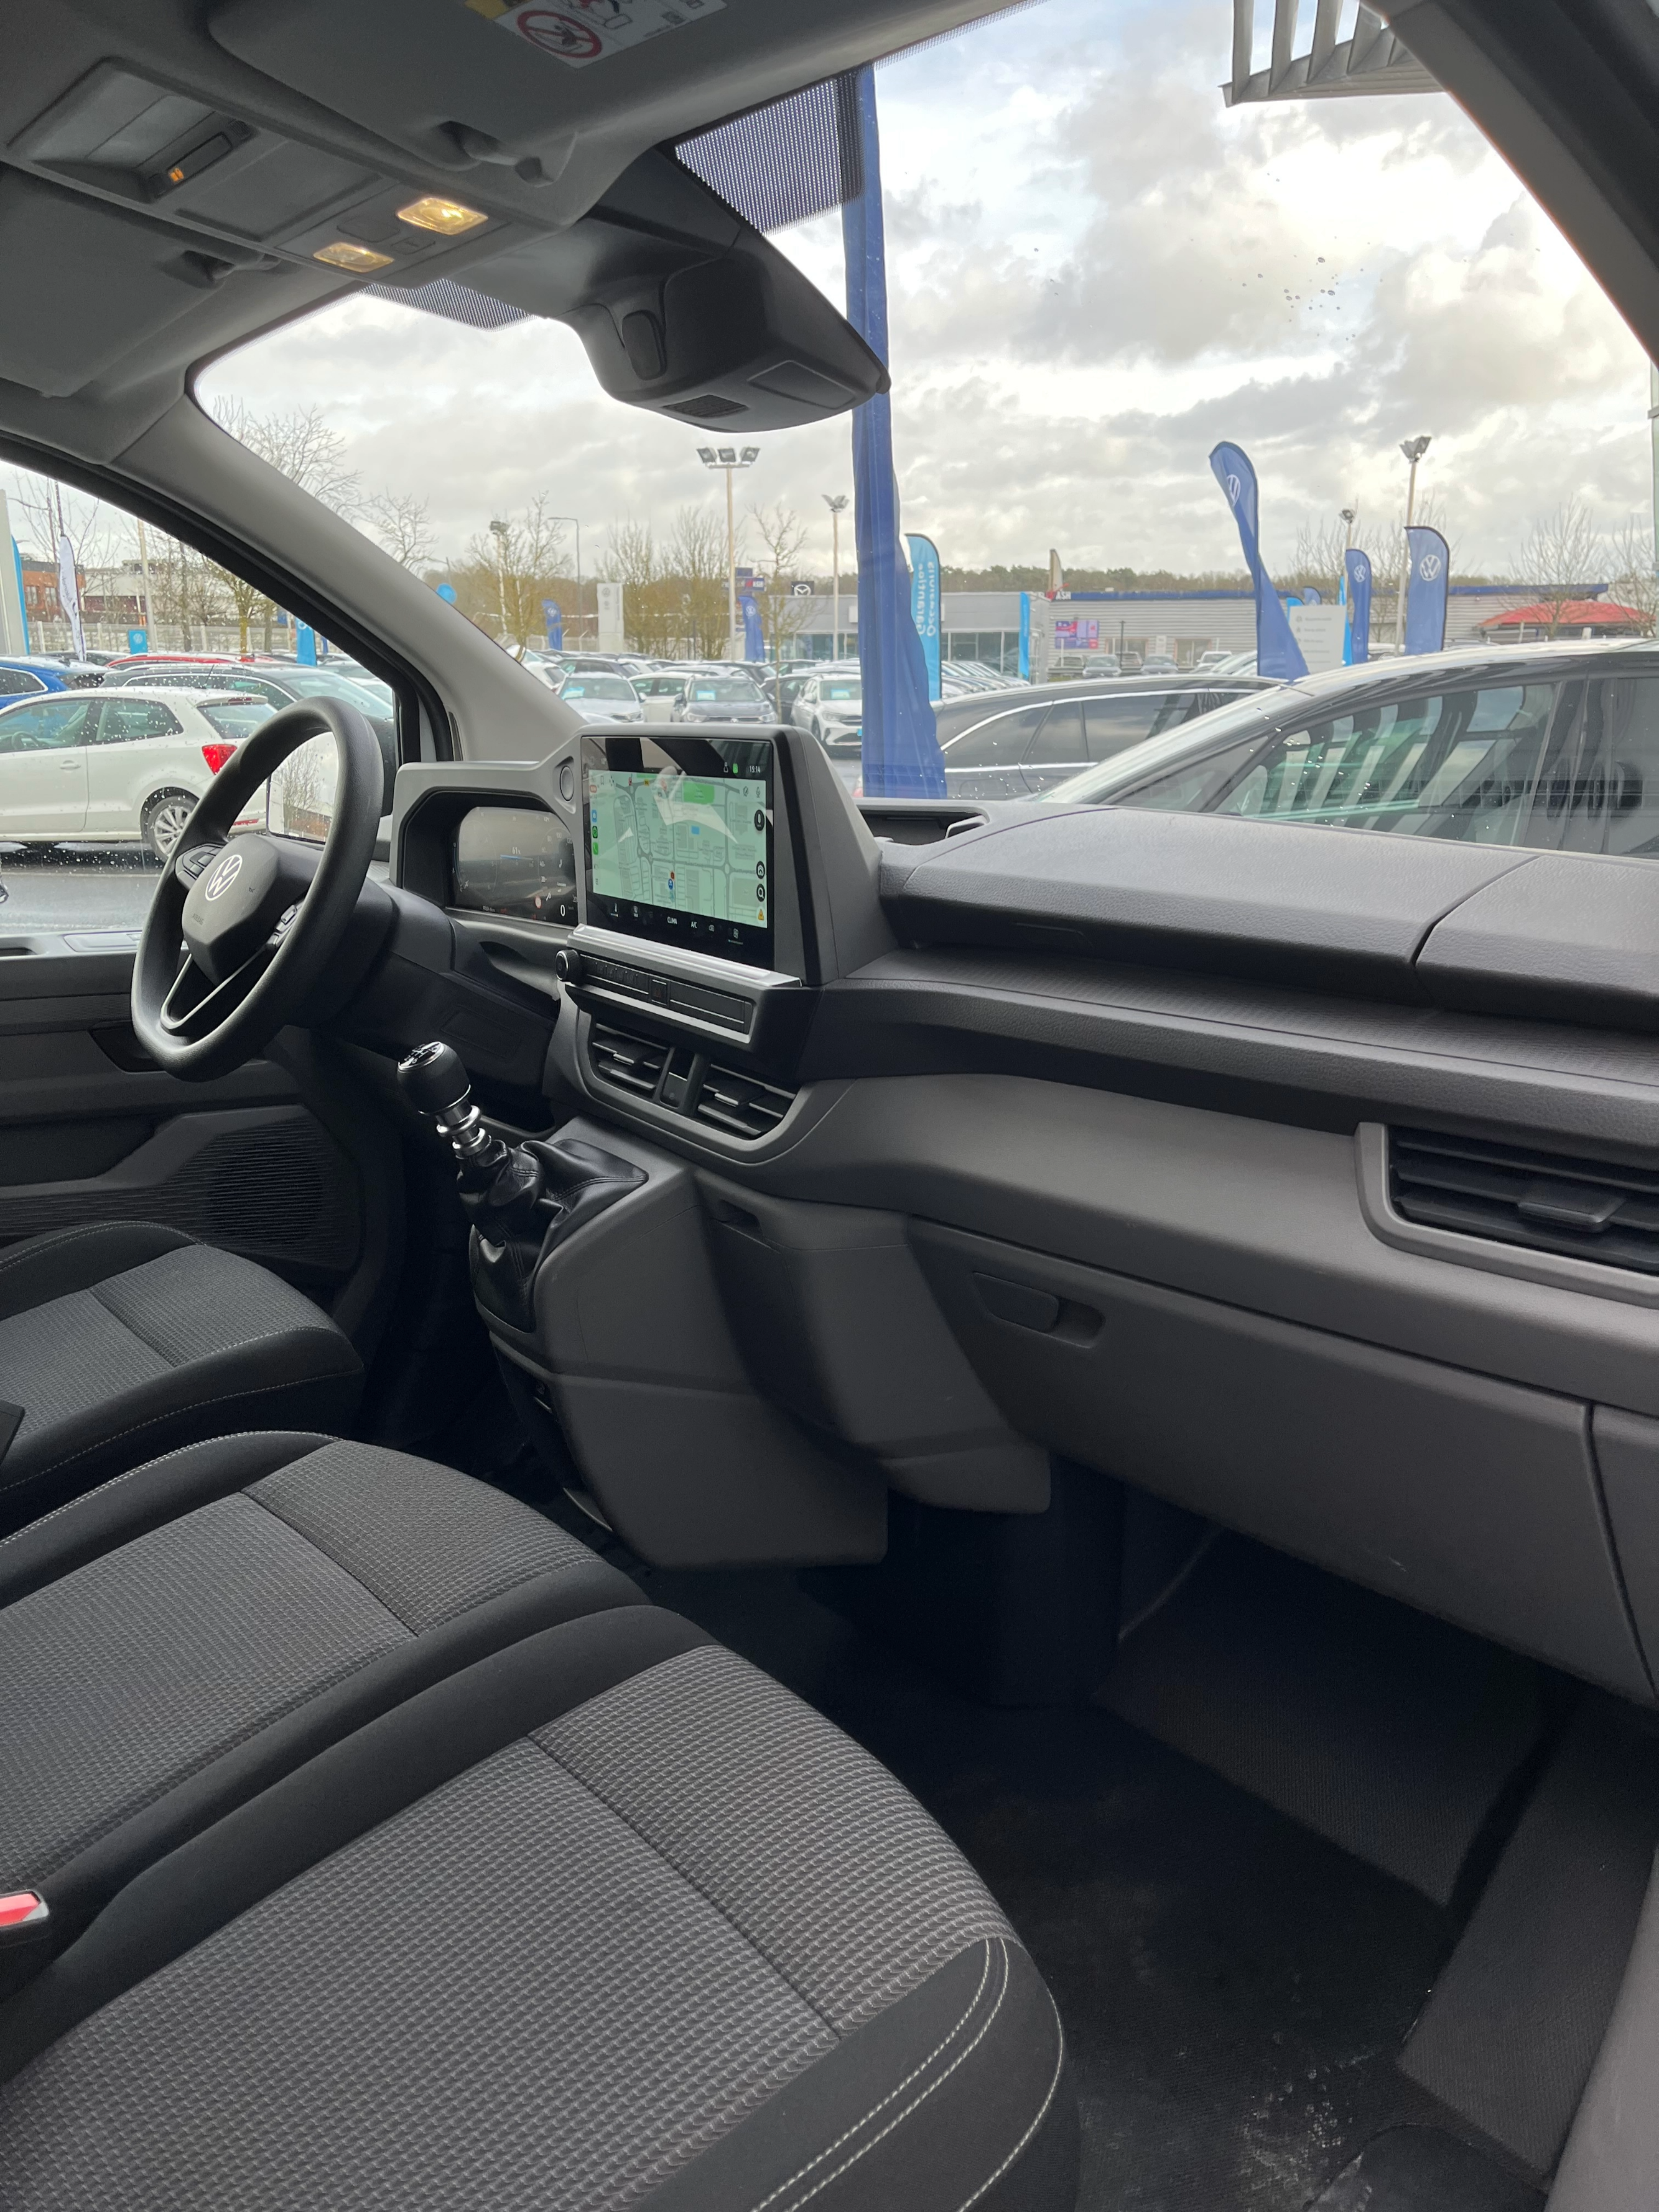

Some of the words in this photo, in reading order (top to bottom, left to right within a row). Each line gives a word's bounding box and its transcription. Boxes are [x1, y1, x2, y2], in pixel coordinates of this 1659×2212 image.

[560, 904, 566, 917] 0
[192, 913, 205, 926] AIRBAG
[667, 916, 678, 925] CLIMA
